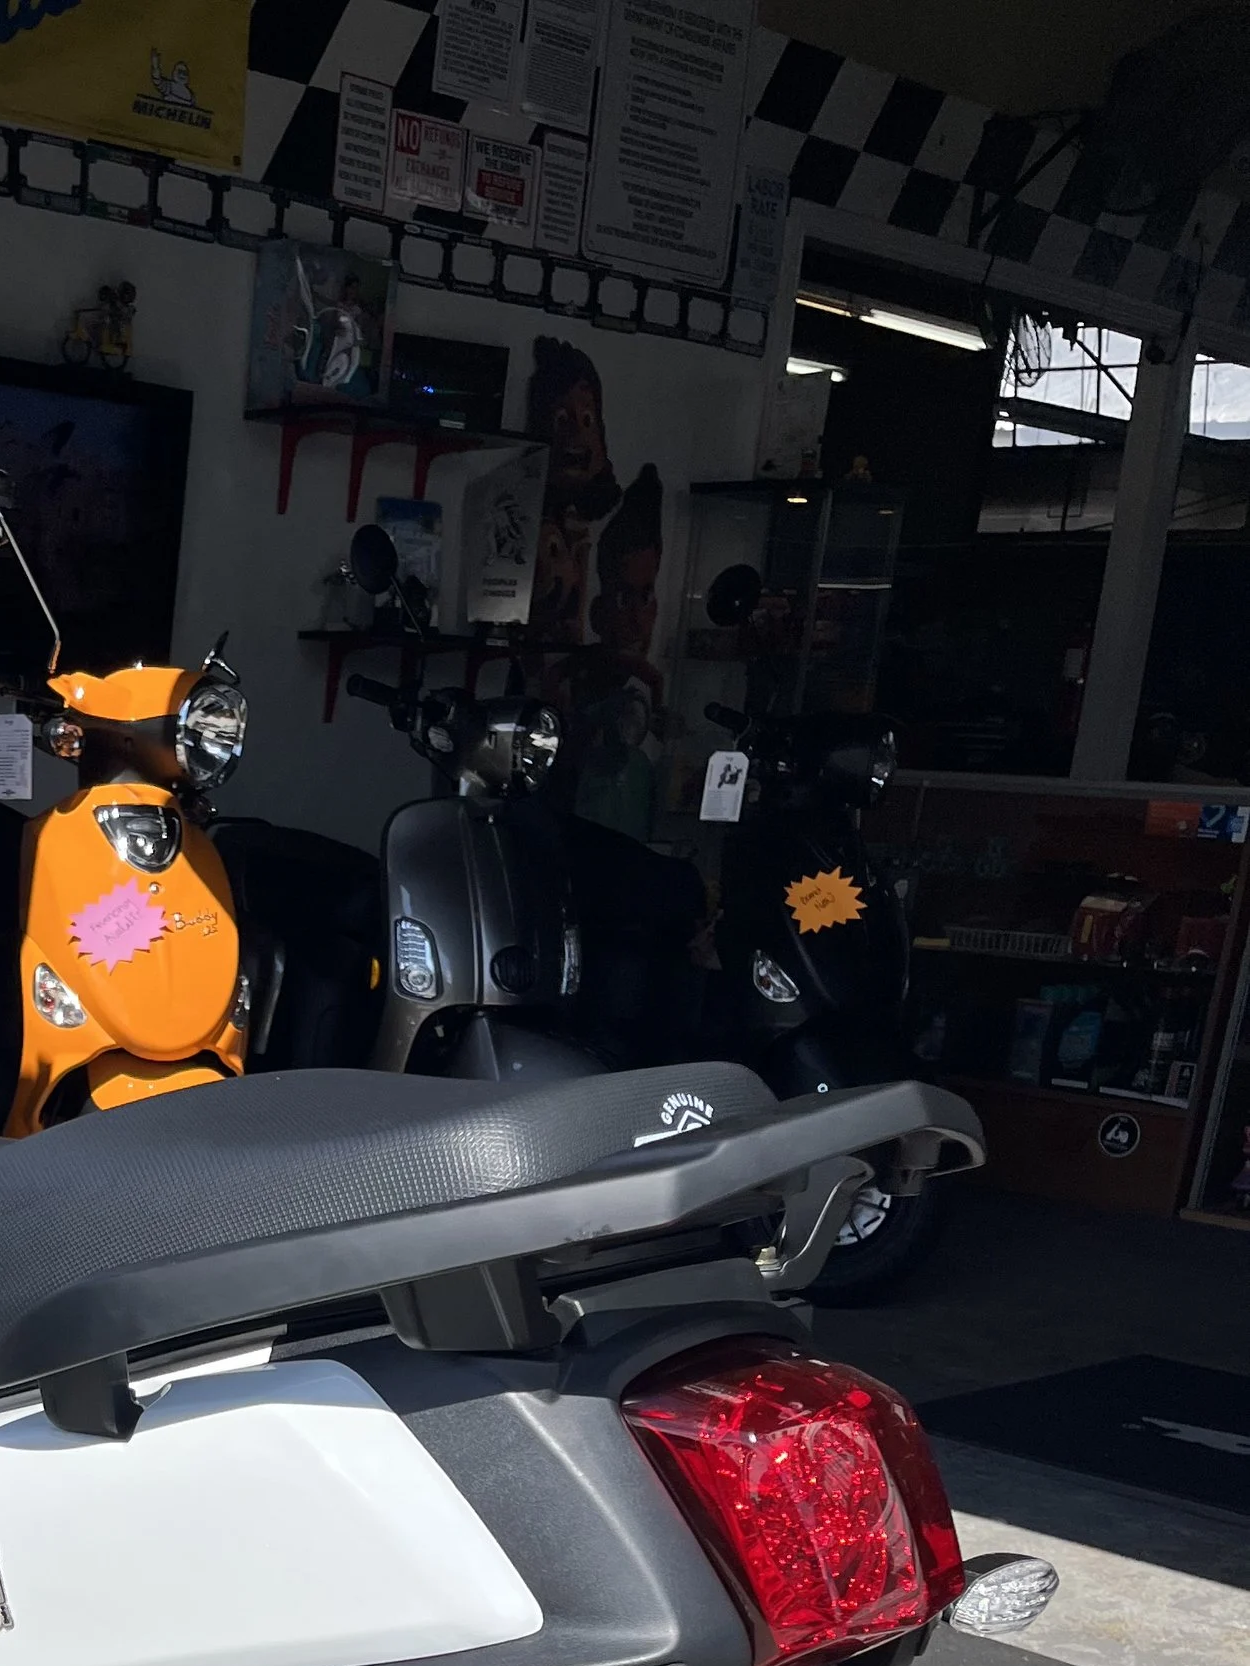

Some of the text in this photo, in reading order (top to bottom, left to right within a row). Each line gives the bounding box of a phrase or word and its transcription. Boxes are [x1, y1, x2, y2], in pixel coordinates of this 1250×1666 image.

[132, 101, 212, 129] MICHELIN
[397, 116, 421, 151] NO
[660, 1092, 714, 1125] GENUINE
